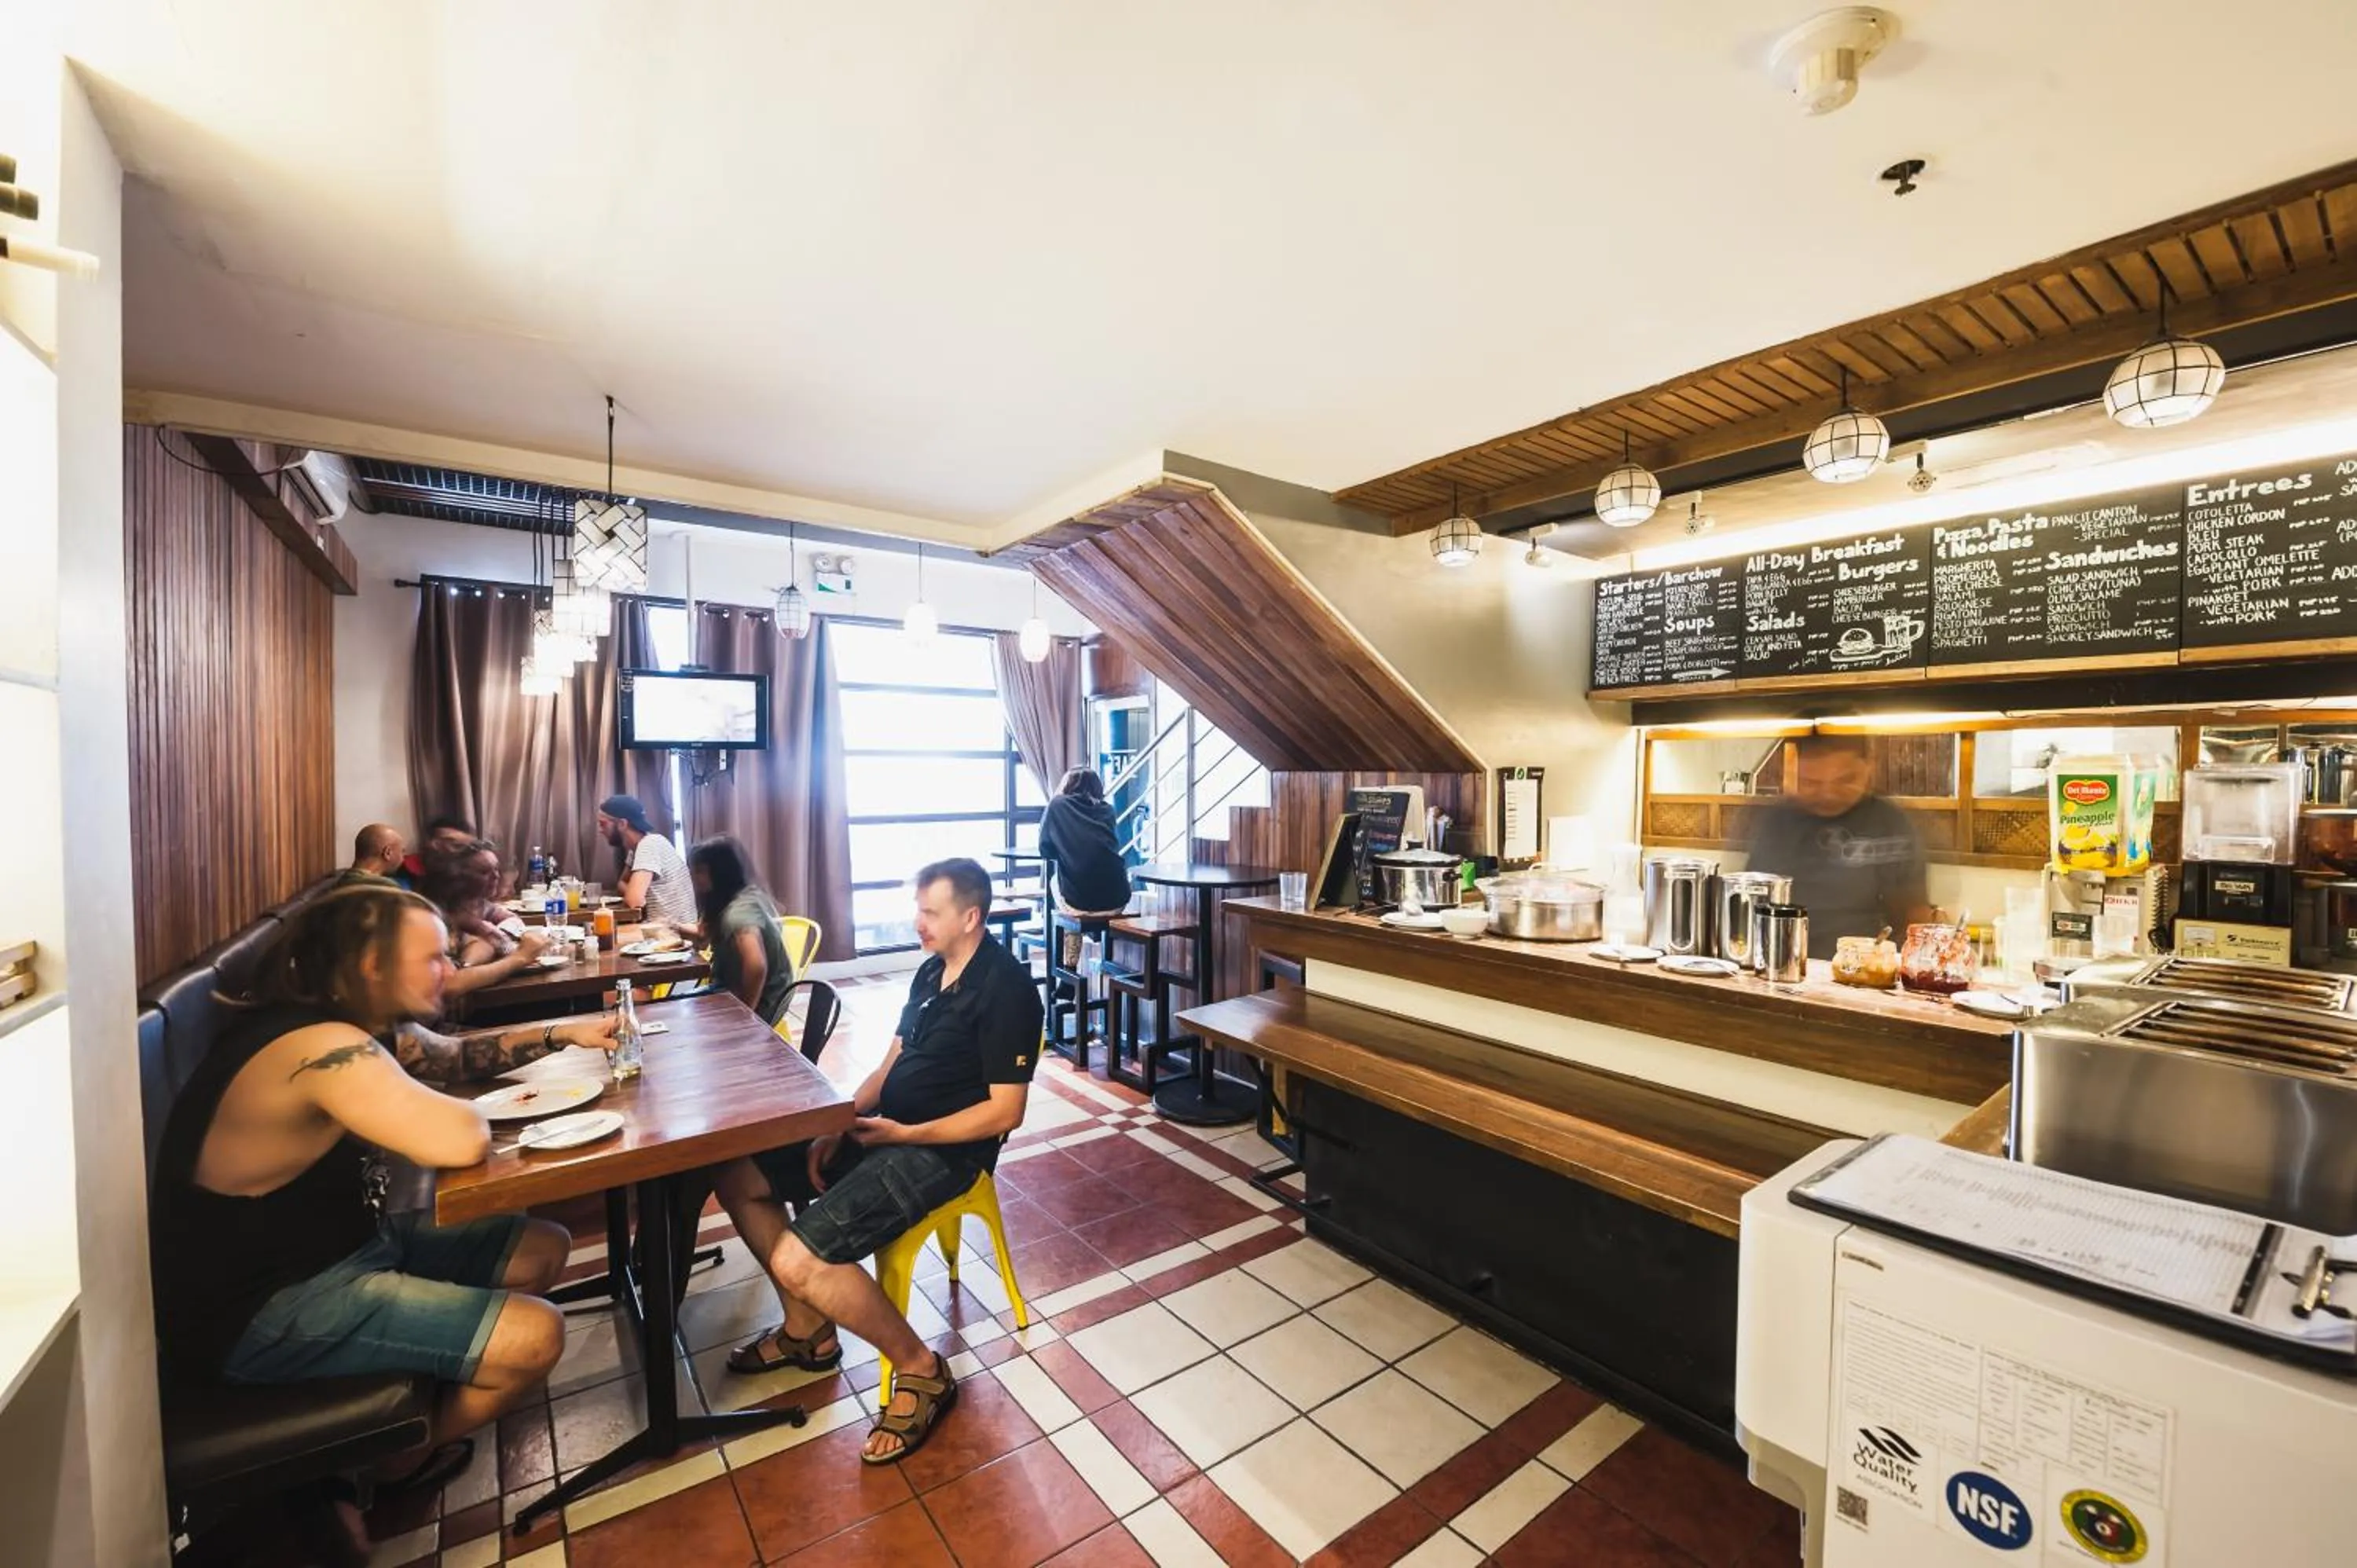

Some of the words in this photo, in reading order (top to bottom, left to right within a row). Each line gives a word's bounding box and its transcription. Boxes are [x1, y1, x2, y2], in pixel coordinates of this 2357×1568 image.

[2187, 474, 2312, 507] Entrees
[2051, 512, 2091, 526] PANCIT
[2093, 504, 2138, 522] CANTON
[2187, 516, 2234, 533] CHICKEN
[2237, 508, 2286, 526] CORDON
[2188, 503, 2254, 520] COTOLETTA
[1988, 513, 2048, 535] Pasta
[2187, 529, 2220, 543] BLEU
[2187, 541, 2220, 555] PORK
[2225, 533, 2265, 549] STEAK
[1746, 552, 1805, 573] All-Day
[1811, 533, 1905, 563] Breakfast
[1951, 534, 2034, 558] Noodles
[2044, 539, 2179, 570] Sandwiches
[2187, 547, 2257, 567] CAPOCOLLO
[2187, 558, 2249, 577] EGGPLANT
[2254, 549, 2320, 566] OMELETTE
[1838, 559, 1920, 582] Burgers
[1934, 559, 1997, 577] MARGHERITA
[2047, 573, 2080, 586] SALAD
[2080, 567, 2139, 581] SANDWICH
[1965, 577, 2003, 590] CHEESE
[2243, 577, 2282, 592] PORK
[1934, 591, 1976, 603] SALAMI
[2047, 593, 2077, 604] OLIVE
[2077, 588, 2122, 603] SALAME
[2187, 592, 2249, 606] PINAKBET
[2047, 600, 2106, 615] SANDWICH
[2235, 610, 2277, 624] PORK
[1664, 615, 1715, 635] Soups
[1746, 611, 1805, 632] Salads
[2047, 610, 2111, 625] PROSCIUTTO
[2047, 620, 2110, 634] SANDWICH
[1931, 636, 1988, 649] SPAGHETTI
[2094, 627, 2153, 640] SANDWICH
[2060, 811, 2115, 825] Pineapple
[1857, 1441, 1914, 1477] Water
[1853, 1452, 1918, 1494] Quality
[1957, 1481, 2020, 1537] NSF
